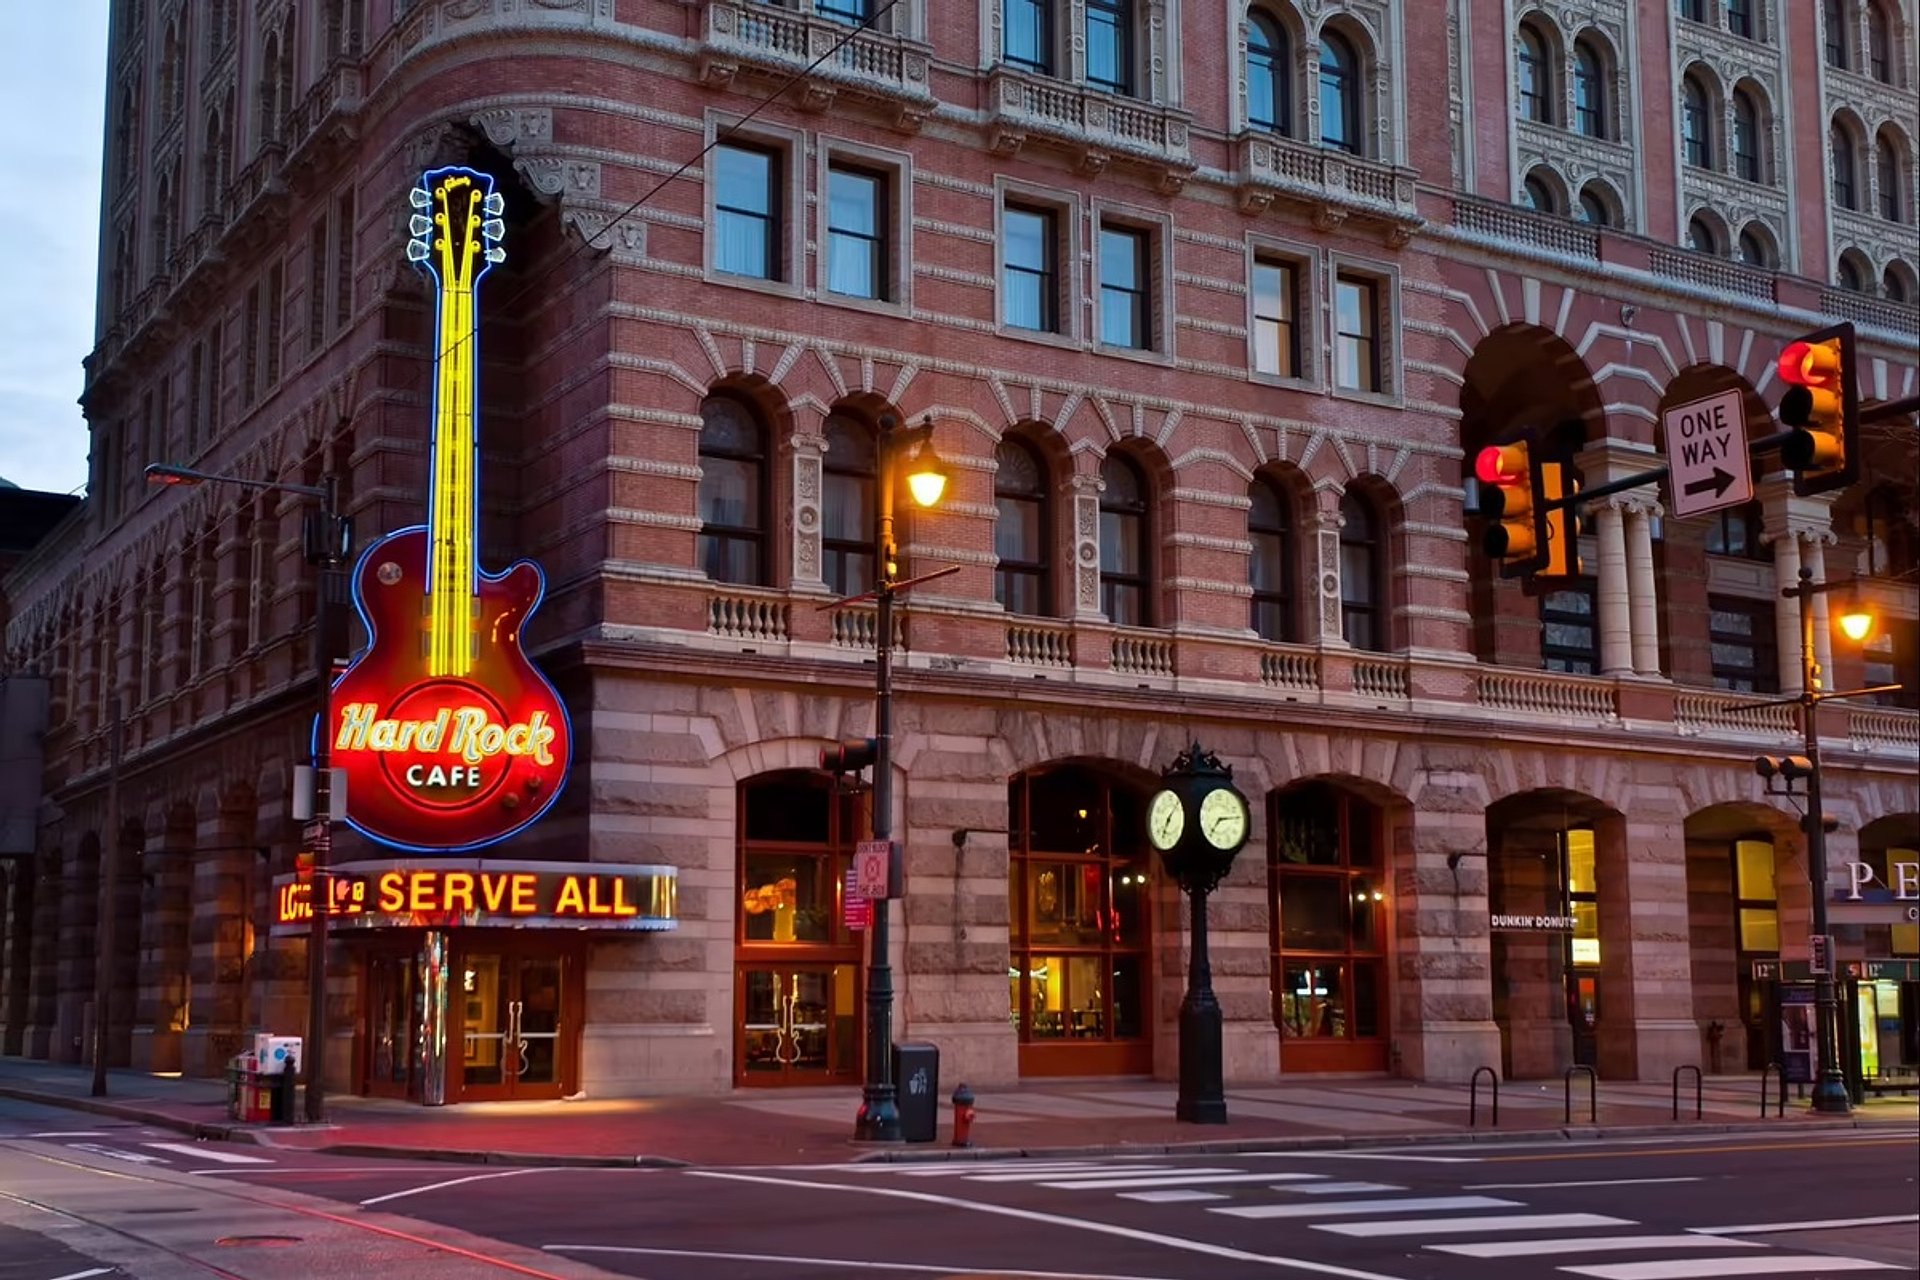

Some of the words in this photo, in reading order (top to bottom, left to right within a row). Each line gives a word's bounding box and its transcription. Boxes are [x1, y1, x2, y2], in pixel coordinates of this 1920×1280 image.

[1681, 405, 1728, 438] ONE
[1682, 432, 1731, 467] WAY
[335, 703, 452, 752] Hard
[448, 706, 555, 766] Rock
[406, 765, 480, 787] CAFE
[379, 872, 537, 912] SERVE
[555, 876, 638, 915] ALL
[1491, 914, 1534, 928] DUNKIN'
[1535, 915, 1577, 928] DONUTS
